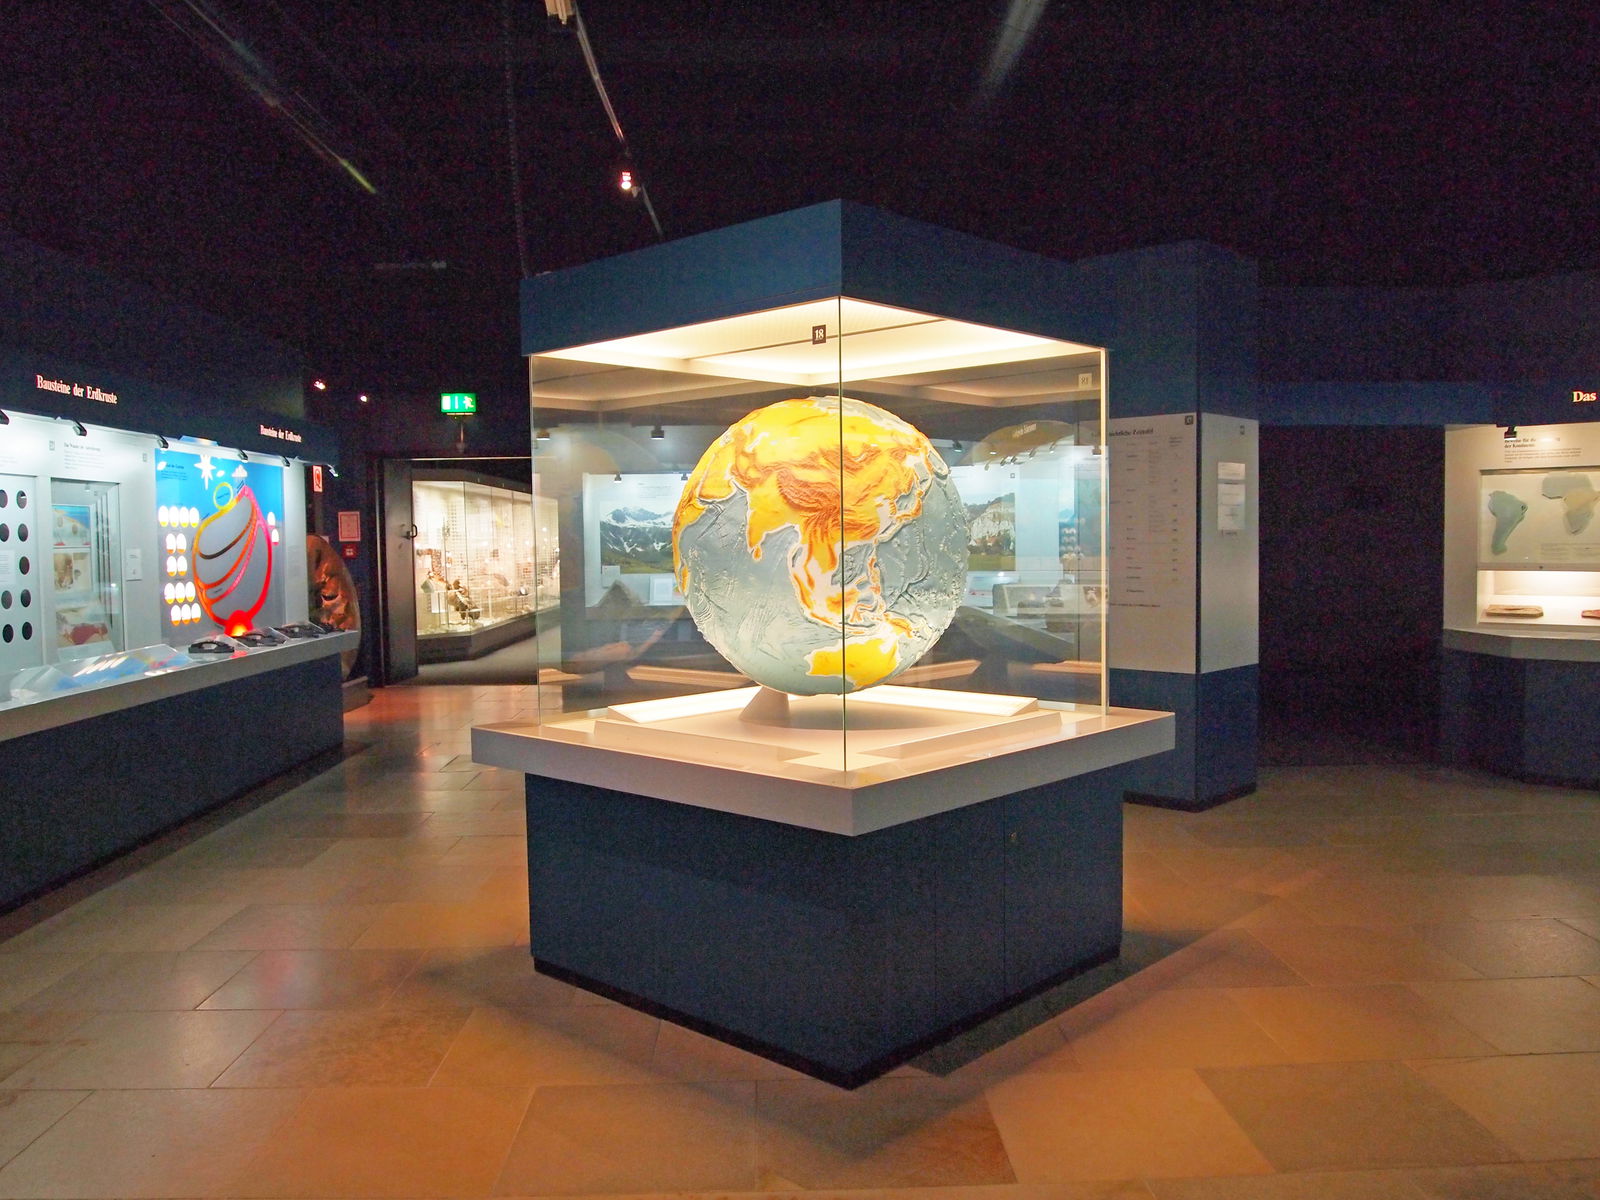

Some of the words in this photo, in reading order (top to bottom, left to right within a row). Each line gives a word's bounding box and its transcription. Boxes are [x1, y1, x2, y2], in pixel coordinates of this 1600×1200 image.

[815, 328, 824, 340] 18
[36, 374, 71, 395] Bausteine
[72, 383, 84, 398] der
[86, 385, 118, 404] Erdkruste
[1572, 391, 1597, 403] Das
